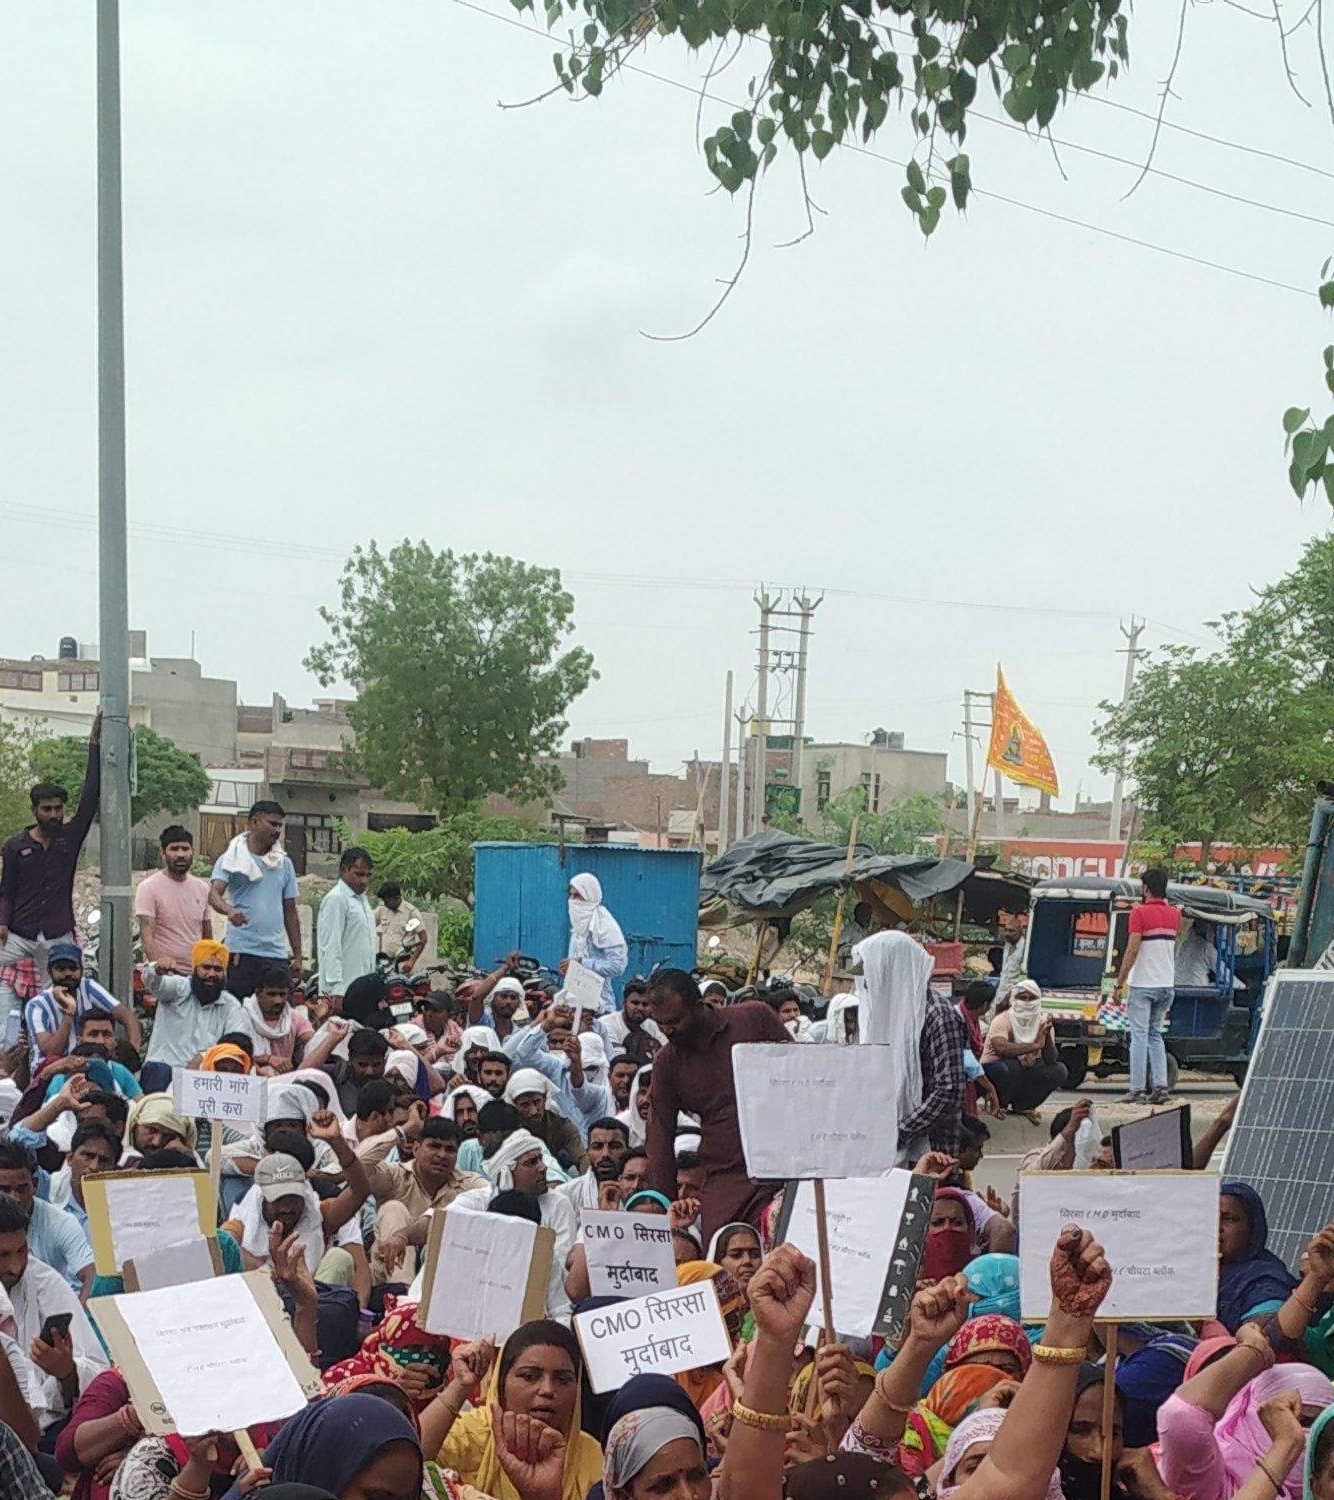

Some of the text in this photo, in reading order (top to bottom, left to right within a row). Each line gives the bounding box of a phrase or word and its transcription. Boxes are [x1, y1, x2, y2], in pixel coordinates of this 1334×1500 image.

[193, 1075, 223, 1092] हमारी
[198, 1096, 216, 1116] पूरी
[1111, 1208, 1141, 1221] मुर्दाबाद
[585, 1223, 671, 1243] CMO सिरसा
[606, 1260, 658, 1289] मुर्दाबाद
[590, 1291, 706, 1339] CMO सिरसा
[620, 1334, 694, 1376] मुर्दाबाद
